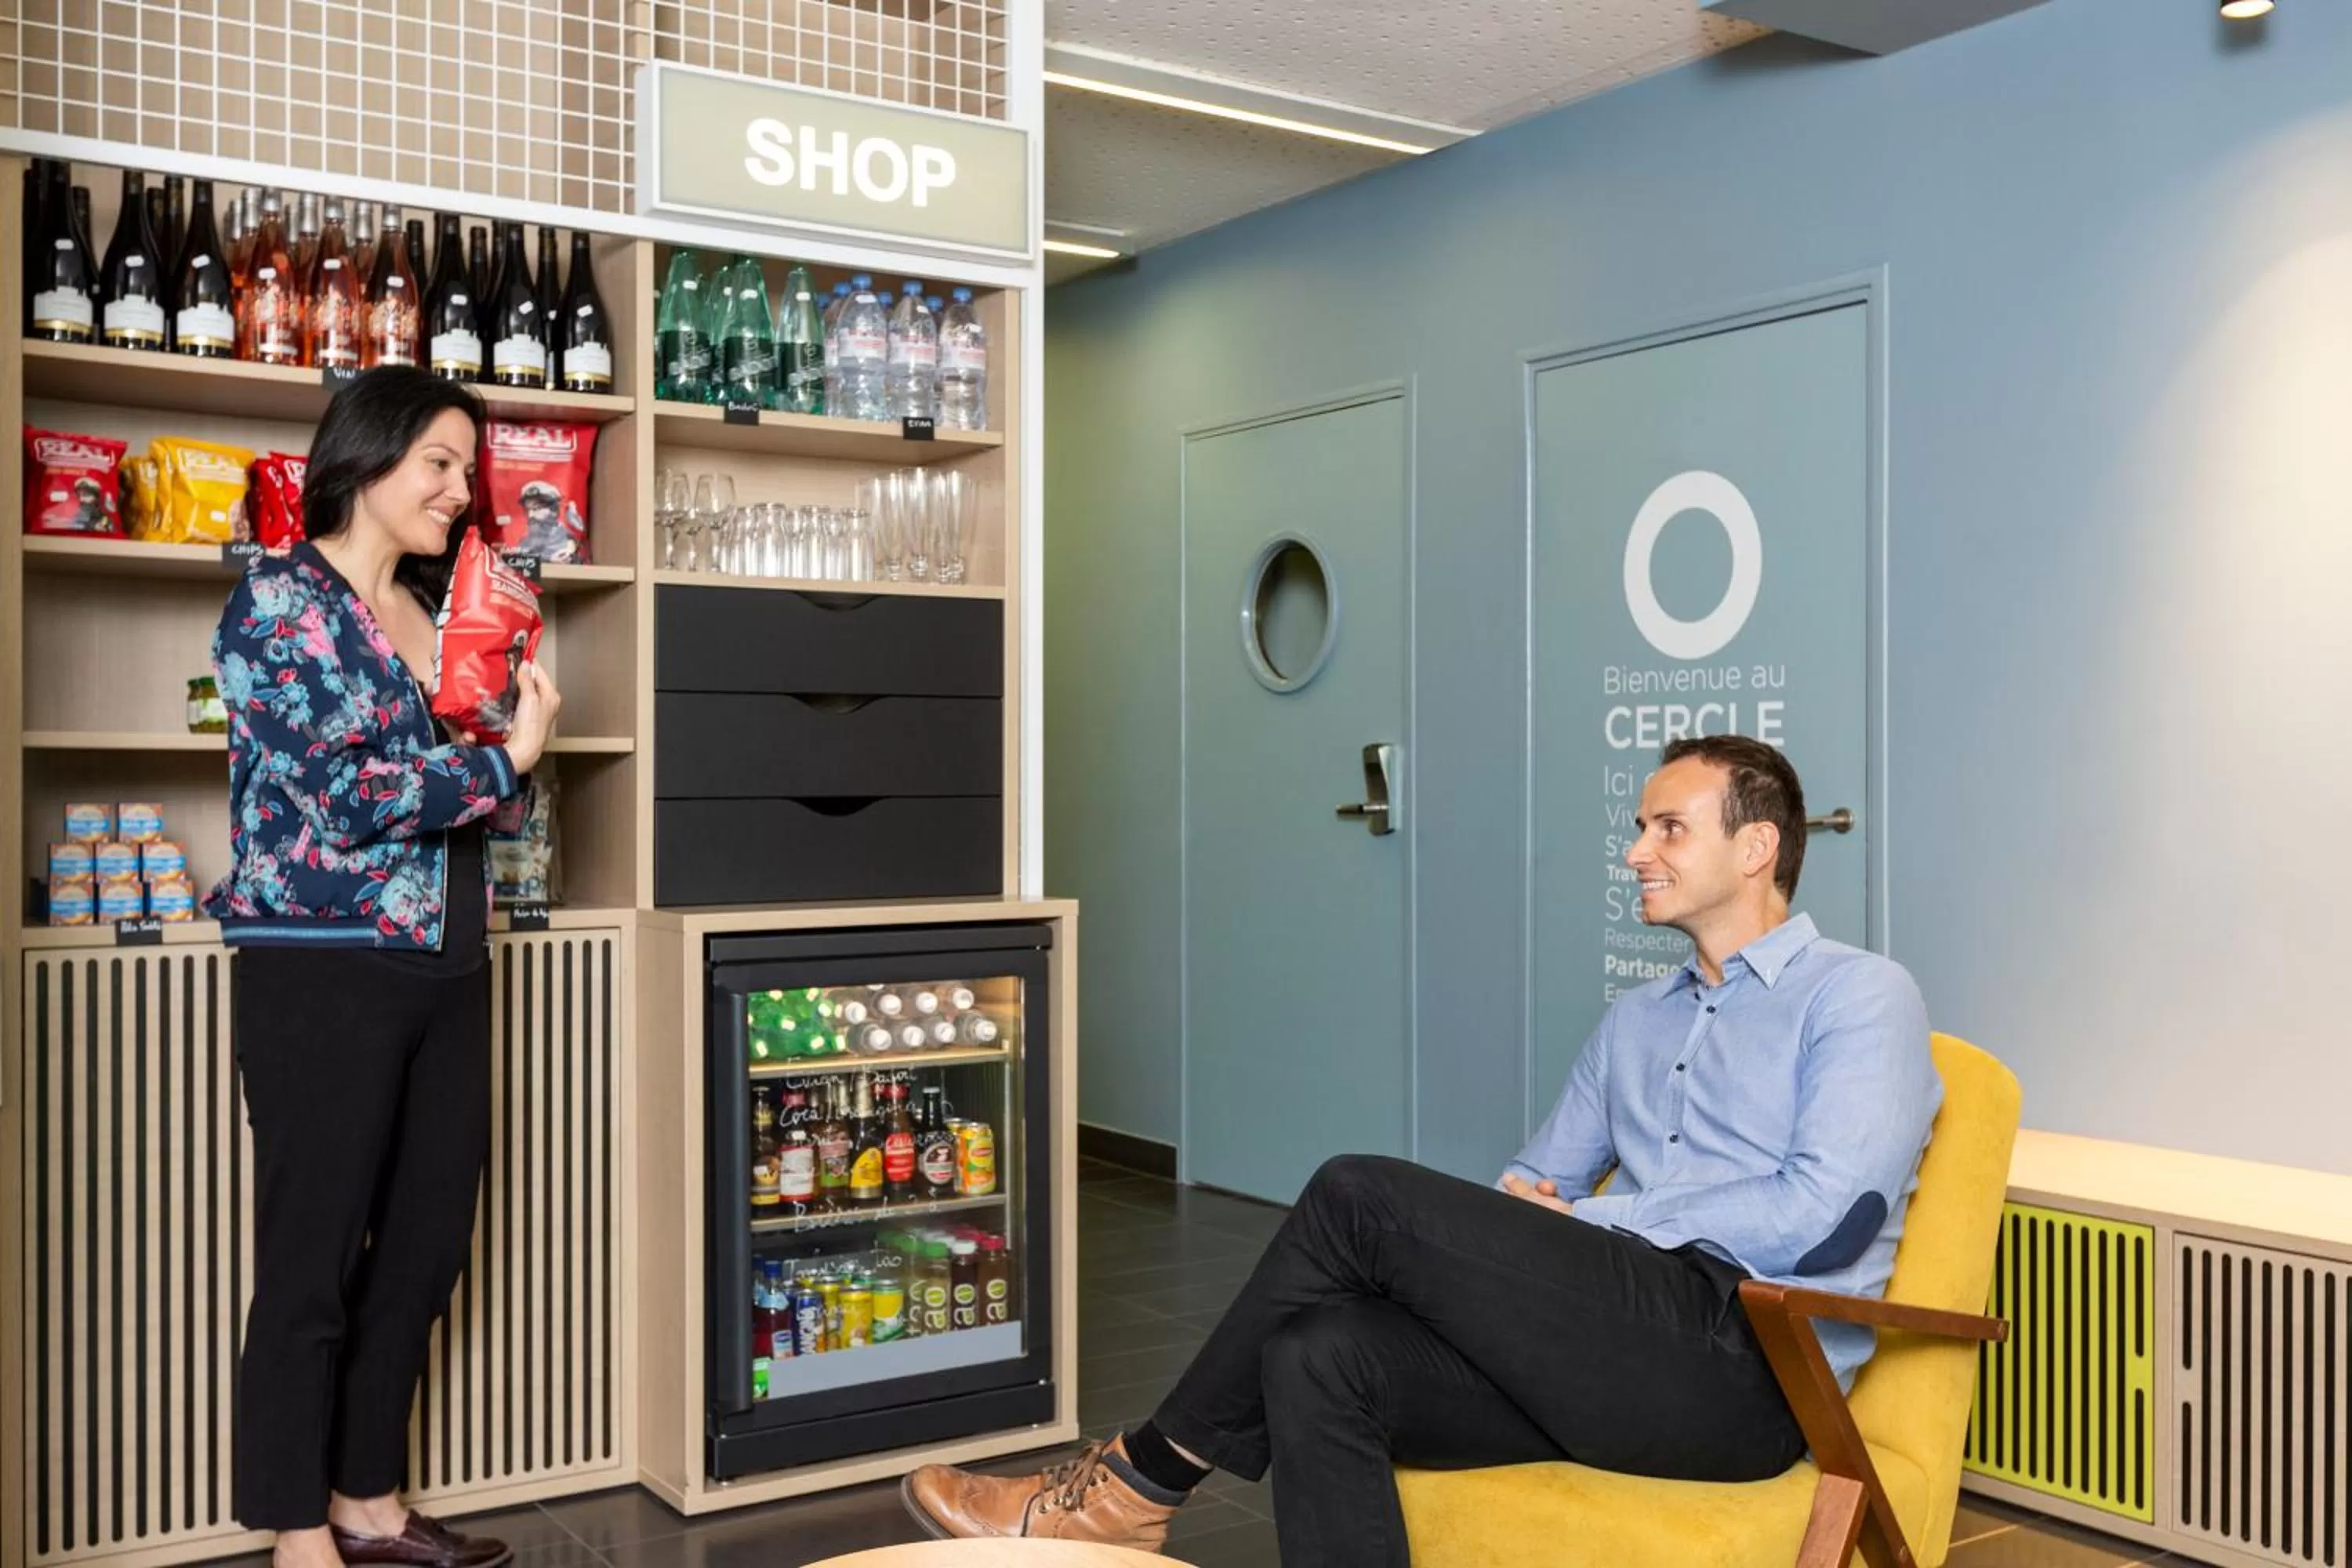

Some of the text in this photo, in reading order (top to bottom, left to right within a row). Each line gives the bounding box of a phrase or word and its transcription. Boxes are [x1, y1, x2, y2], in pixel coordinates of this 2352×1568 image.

[745, 118, 956, 207] SHOP
[494, 423, 572, 448] REAL
[1604, 665, 1785, 695] Bienvenue au
[1605, 764, 1633, 797] Ici
[1605, 803, 1639, 828] Viv
[1606, 834, 1632, 857] S'a
[1606, 865, 1639, 882] Trav
[1606, 886, 1644, 924] S'e
[1605, 928, 1691, 954] Respecter
[924, 1286, 947, 1331] ao
[953, 1283, 976, 1327] ao
[985, 1279, 1007, 1321] ao
